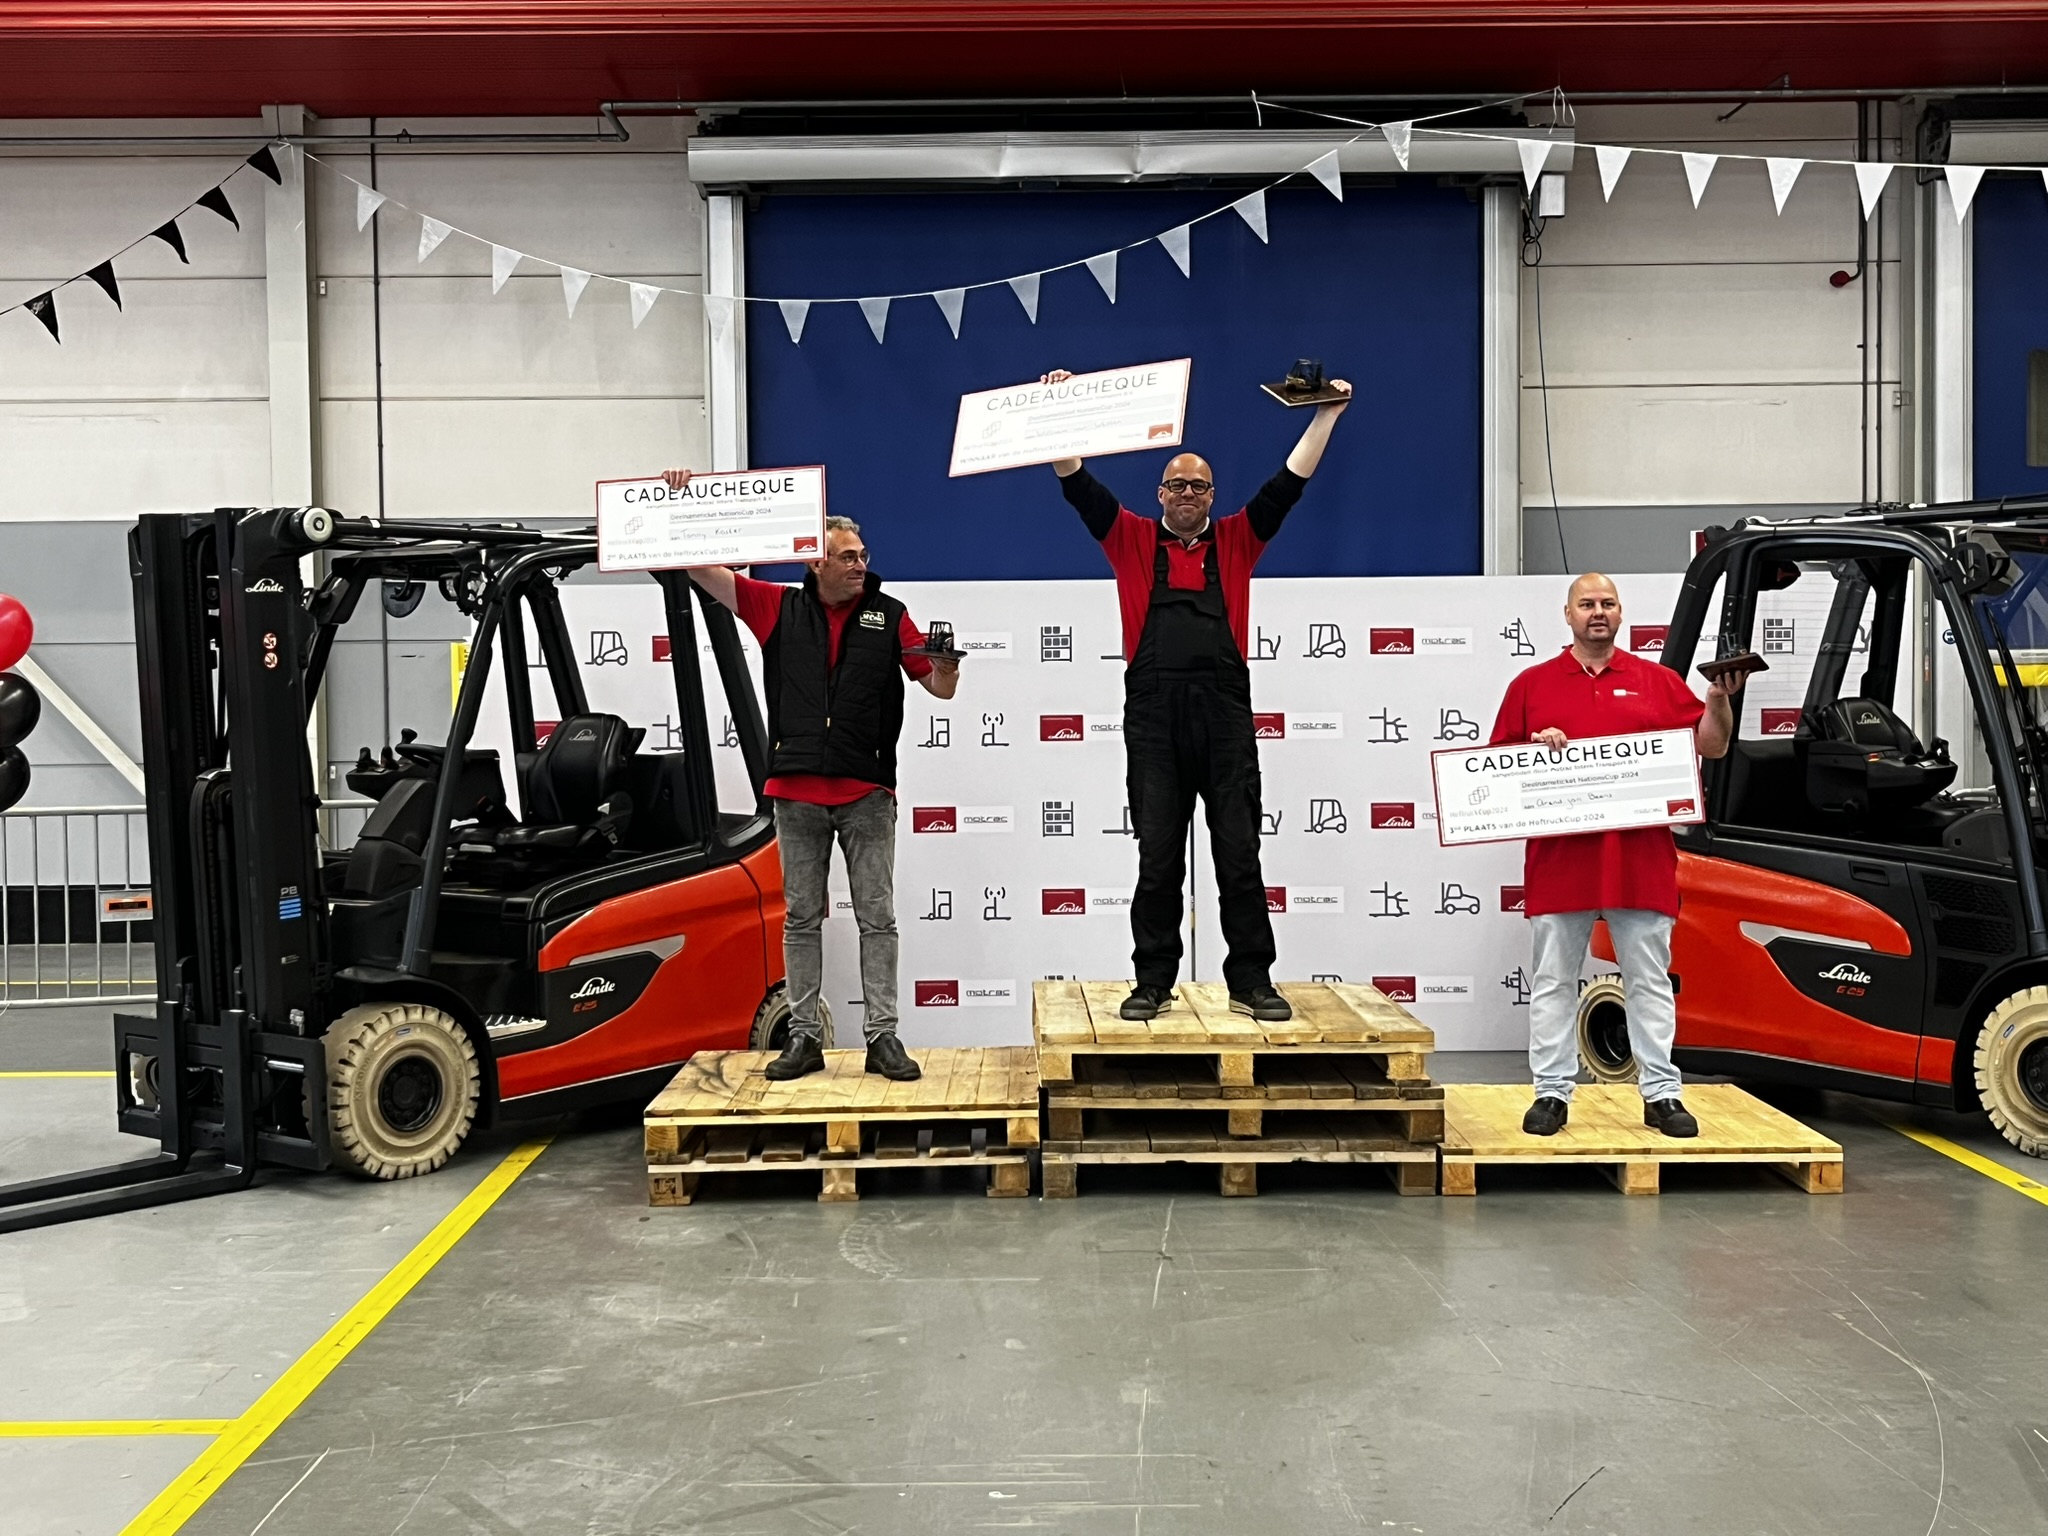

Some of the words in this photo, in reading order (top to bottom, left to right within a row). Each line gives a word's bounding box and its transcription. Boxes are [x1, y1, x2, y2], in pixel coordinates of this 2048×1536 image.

[987, 372, 1158, 411] CADEAUCHEQUE
[624, 477, 795, 503] CADEAUCHEQUE
[245, 578, 284, 592] Linde
[1378, 642, 1412, 653] Linde
[1465, 739, 1664, 773] CADEAUCHEQUE
[1464, 823, 1497, 832] PLAATS
[1583, 813, 1605, 821] 2024
[1818, 963, 1871, 984] Linde
[570, 977, 616, 999] Linde
